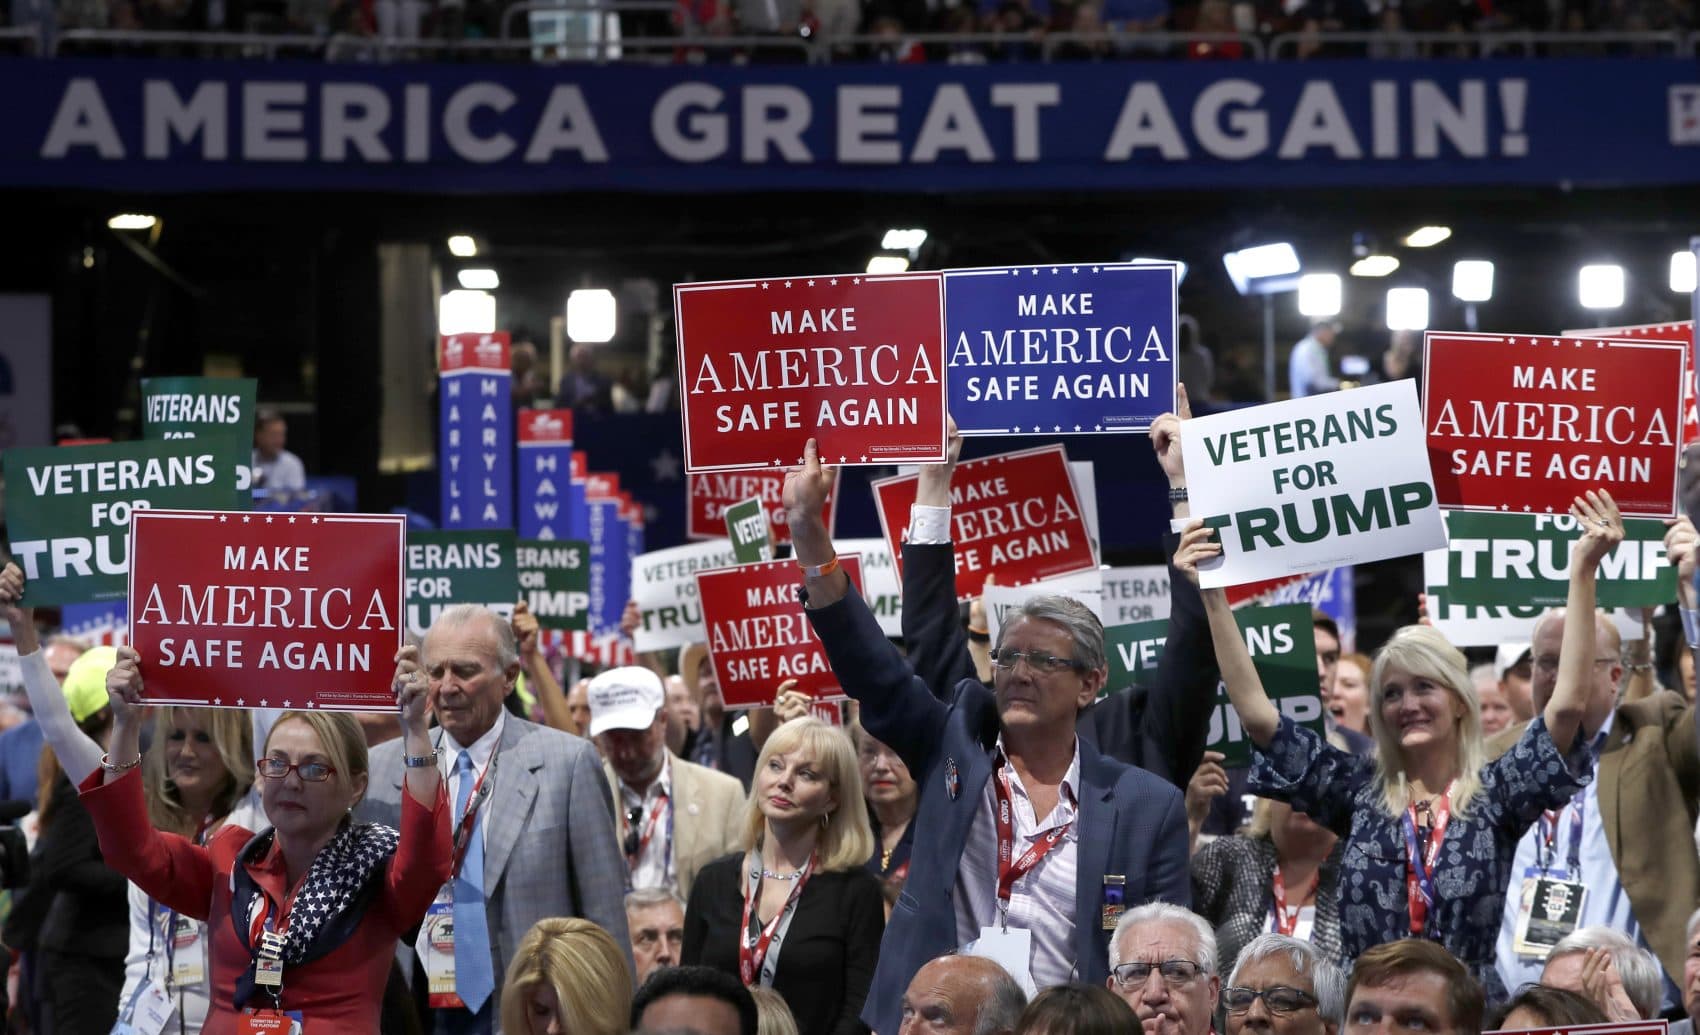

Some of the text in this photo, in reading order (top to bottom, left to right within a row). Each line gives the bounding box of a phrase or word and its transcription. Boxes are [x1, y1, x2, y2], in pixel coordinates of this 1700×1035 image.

[41, 78, 1527, 164] AMERICA GREAT AGAIN!
[771, 307, 857, 335] MAKE
[1018, 293, 1093, 317] MAKE
[948, 325, 1170, 367] AMERICA
[690, 343, 939, 395] AMERICA
[1512, 365, 1596, 392] MAKE
[967, 373, 1149, 401] SAFE AGAIN
[146, 394, 240, 424] VETERANS
[716, 397, 918, 433] SAFE AGAIN
[1430, 398, 1674, 447] AMERICA
[481, 378, 498, 522] MARYLA
[1203, 404, 1397, 467] VETERANS
[27, 455, 216, 497] VETERANS
[1273, 460, 1337, 494] FOR
[1451, 448, 1651, 483] SAFE AGAIN
[534, 454, 559, 541] HAWA
[694, 474, 783, 503] AMER
[948, 476, 1009, 505] MAKE
[952, 492, 1078, 544] ERICA
[1203, 481, 1434, 556] TRUMP
[1535, 514, 1586, 532] FO
[10, 534, 130, 580] TRU
[223, 545, 310, 572] MAKE
[407, 543, 501, 570] ERANS
[516, 547, 580, 570] ERANS
[954, 529, 1069, 576] FE AGAIN
[406, 577, 452, 599] FOR
[675, 583, 698, 598] FO
[746, 582, 800, 608] MAKE
[137, 582, 394, 632] AMERICA
[641, 604, 702, 633] TRU
[1119, 604, 1153, 621] FOR
[712, 611, 820, 654] AMERI
[158, 638, 371, 673] SAFE AGAIN
[727, 651, 828, 682] SAFE AGA
